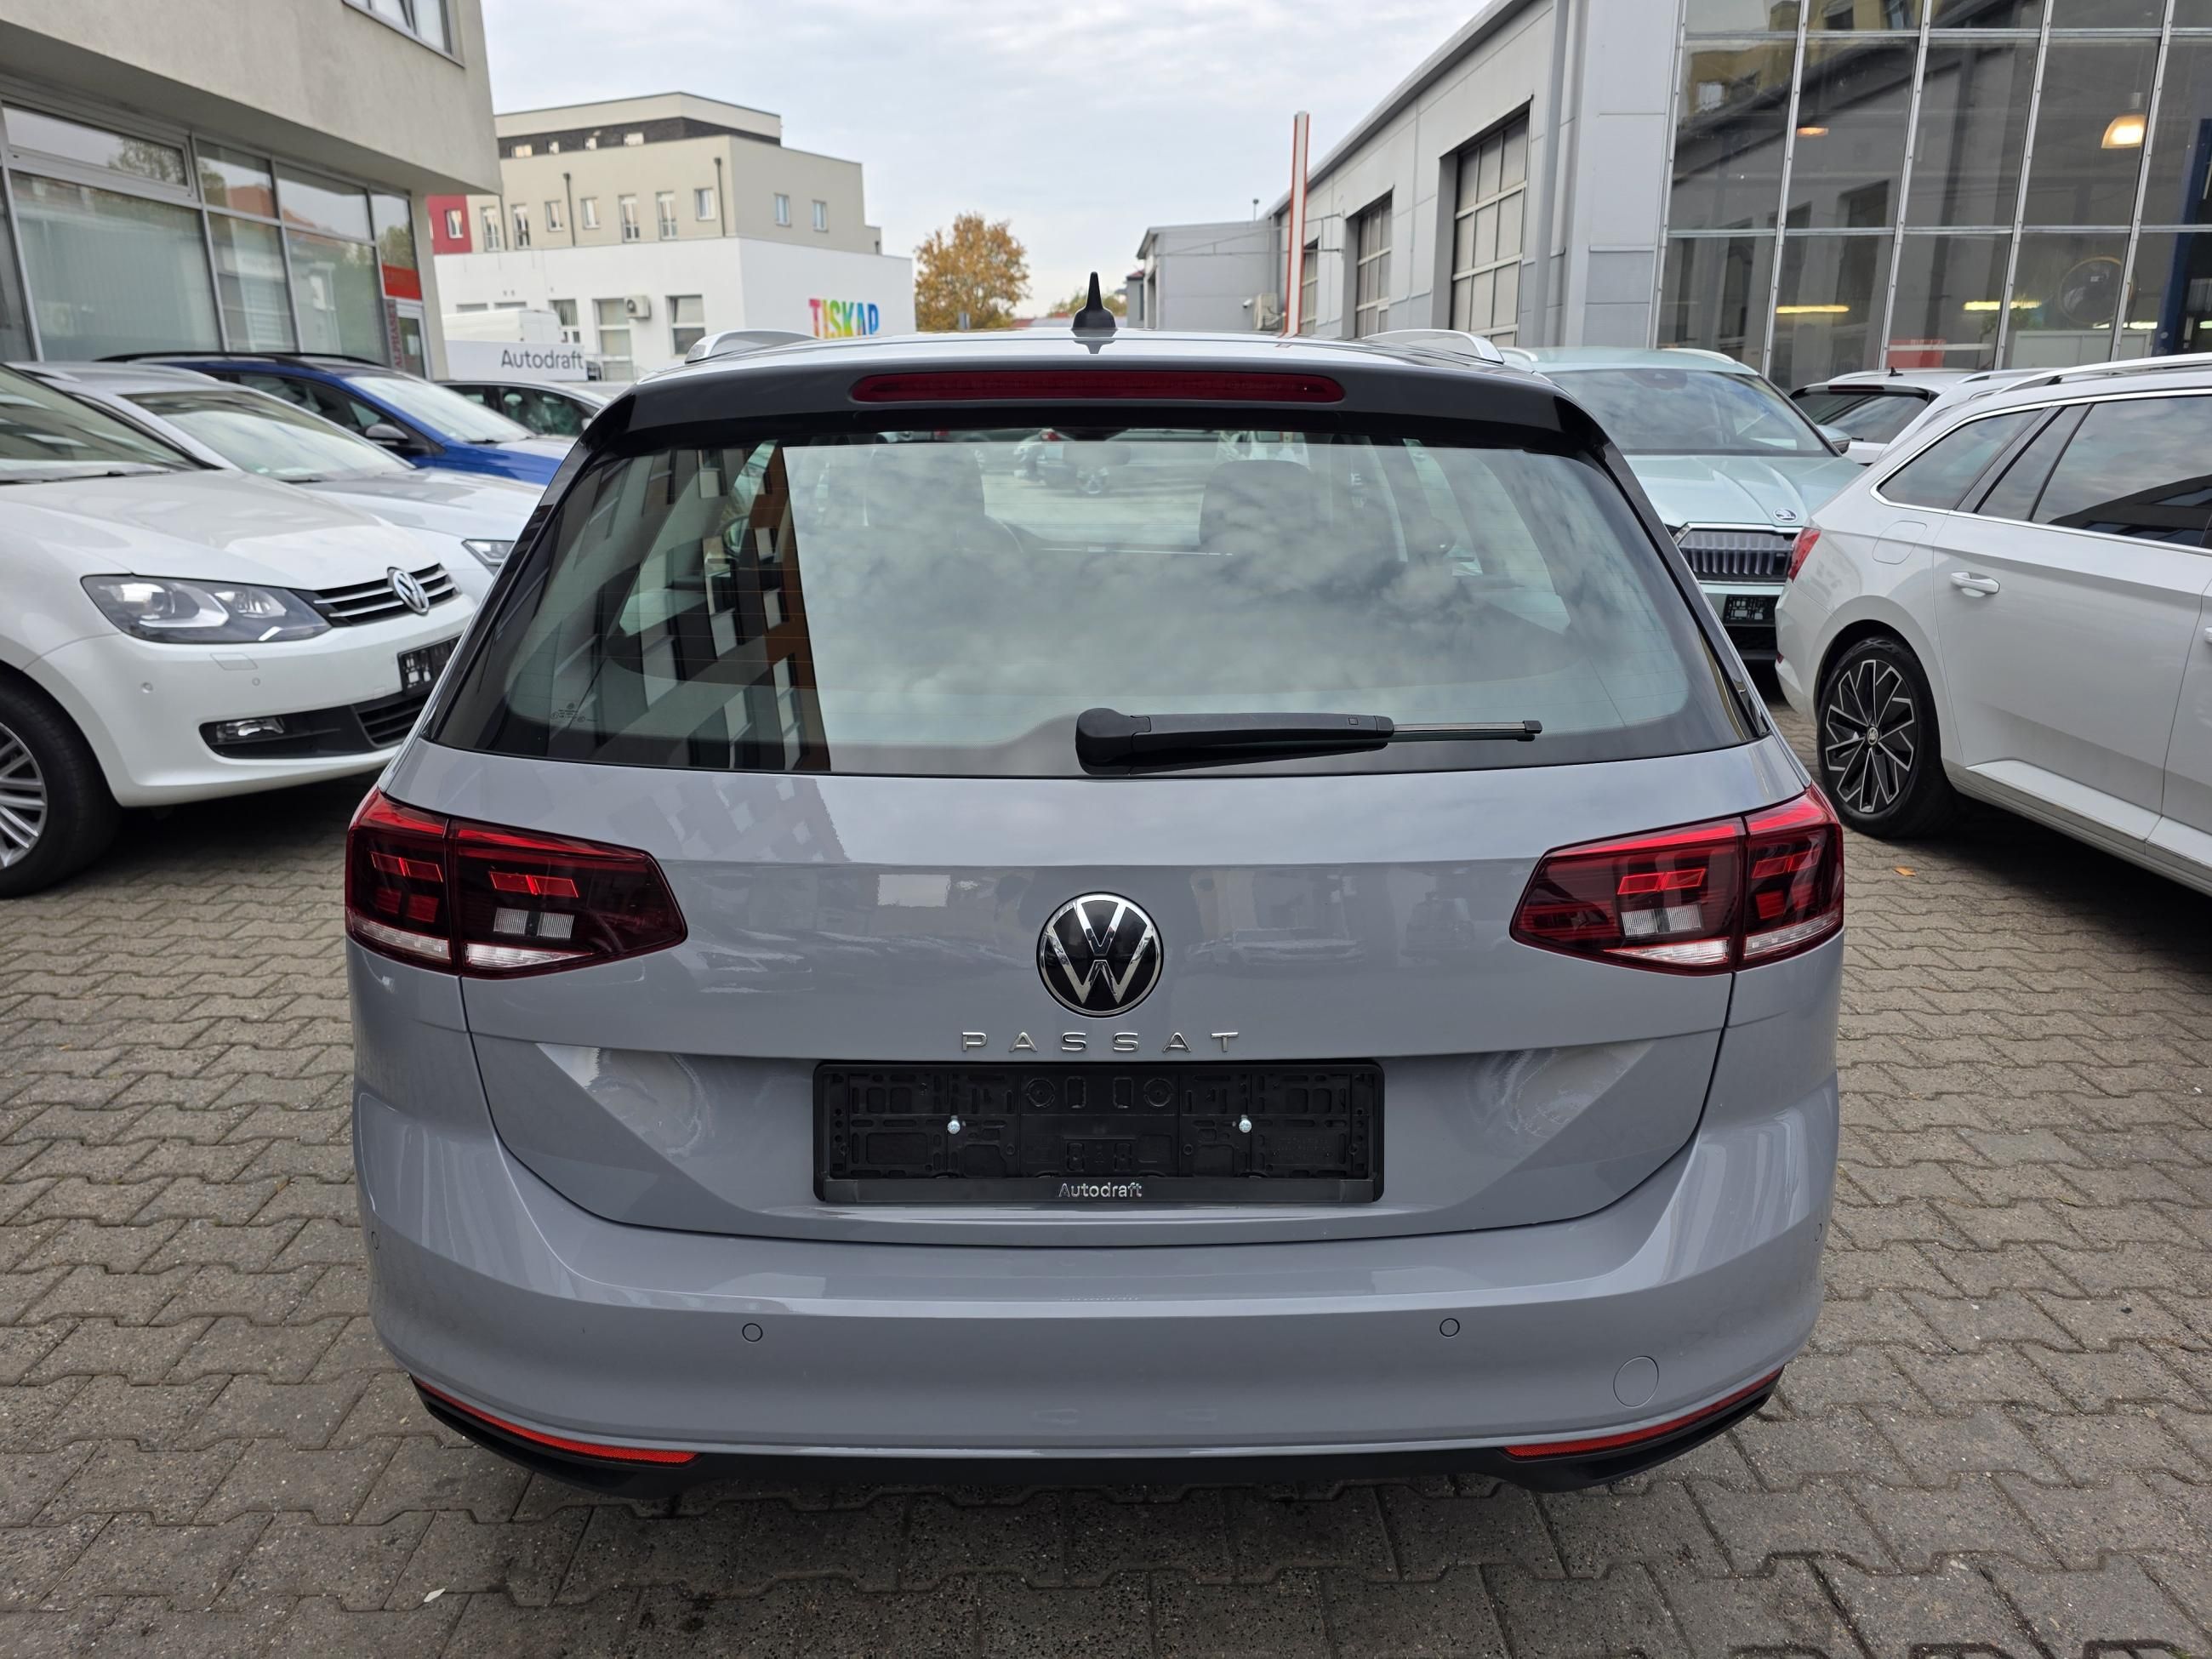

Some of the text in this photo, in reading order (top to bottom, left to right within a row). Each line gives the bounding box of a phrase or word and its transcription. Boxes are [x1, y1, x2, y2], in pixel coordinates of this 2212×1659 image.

[501, 348, 584, 370] Autodraft
[1038, 892, 1163, 1018] VW
[961, 1031, 1239, 1053] PASSAT
[1058, 1182, 1142, 1198] Autodraft
